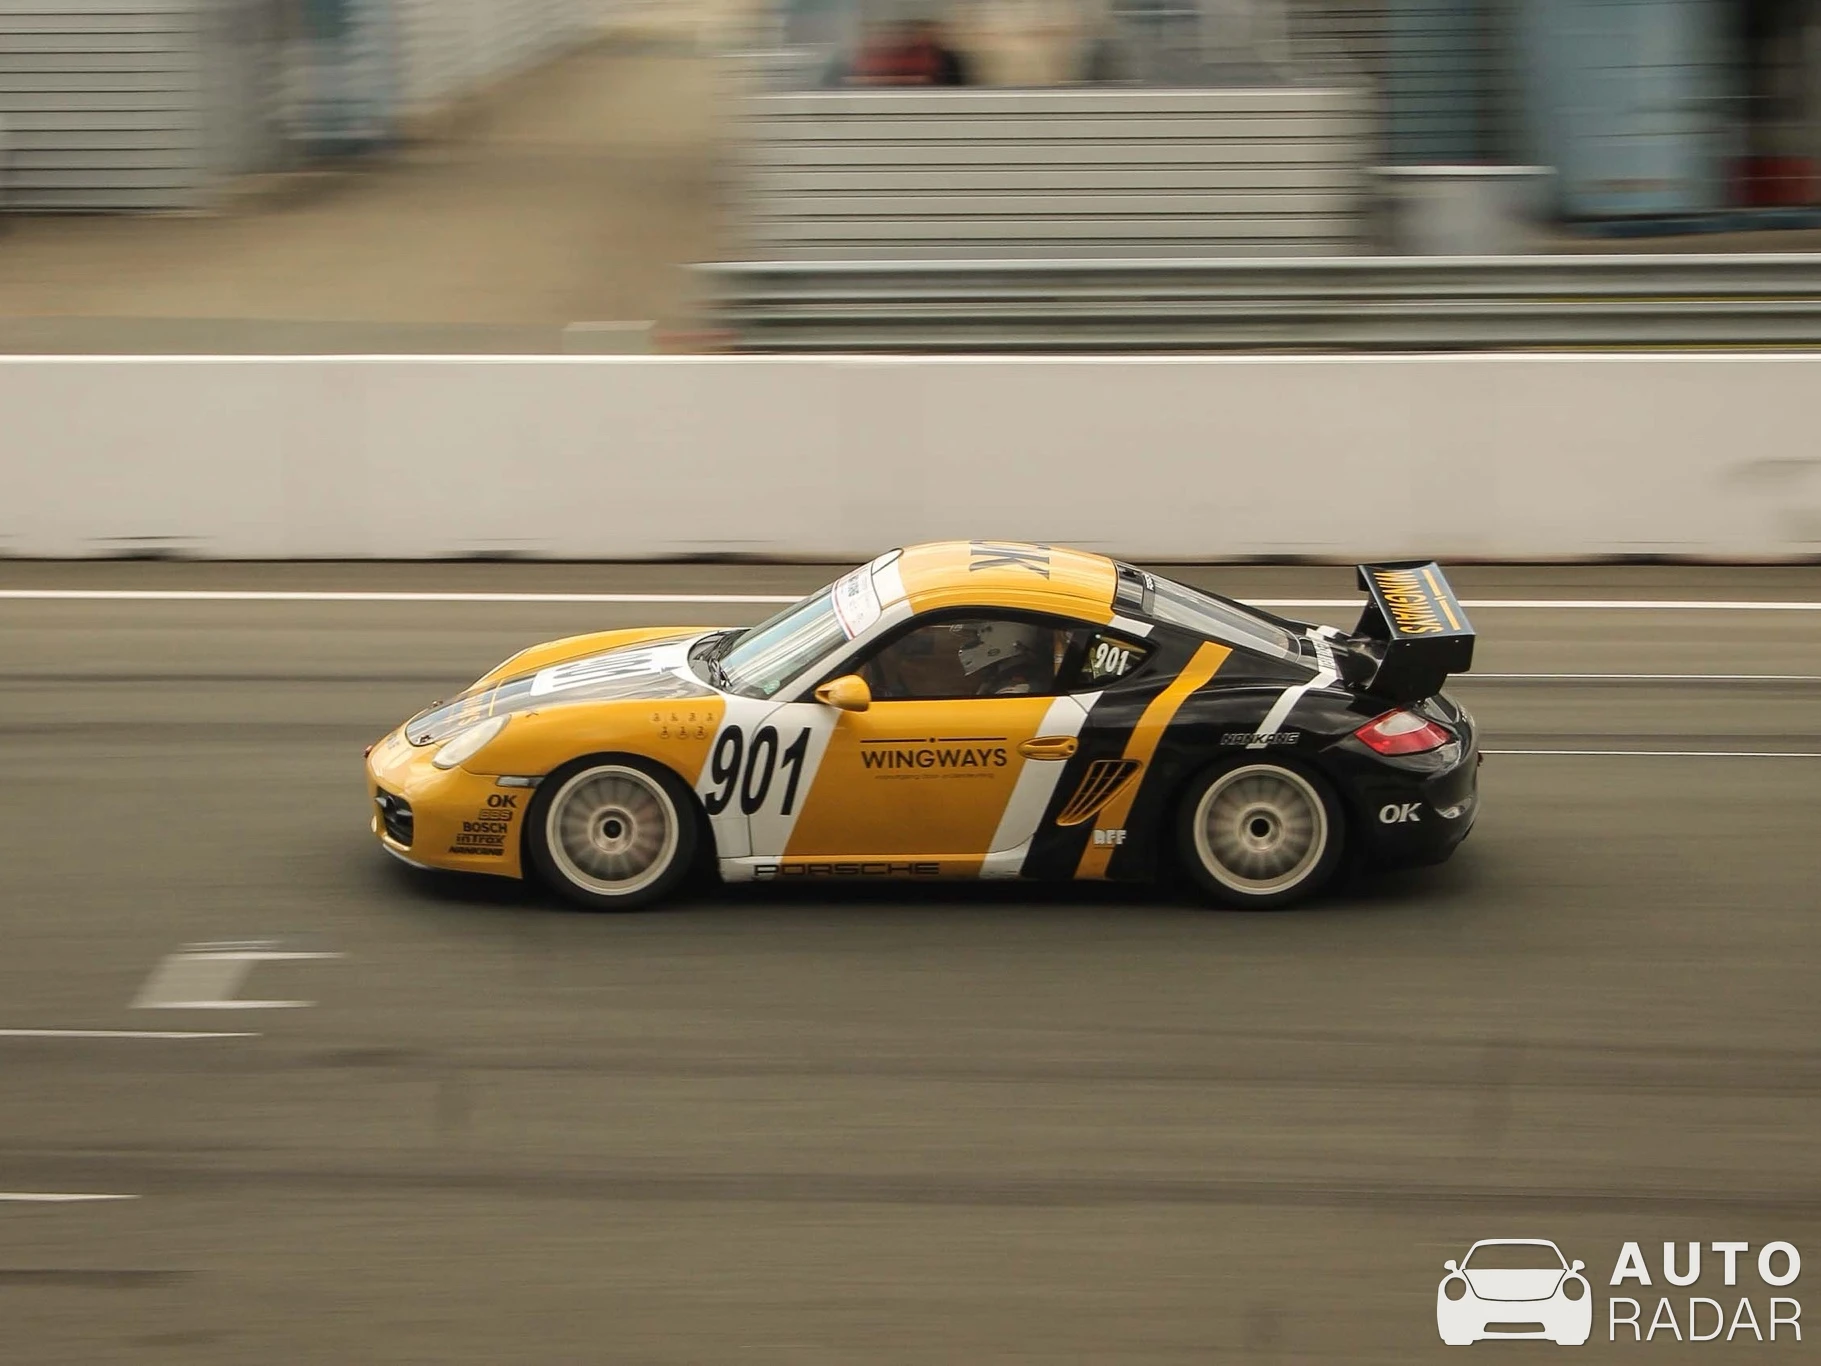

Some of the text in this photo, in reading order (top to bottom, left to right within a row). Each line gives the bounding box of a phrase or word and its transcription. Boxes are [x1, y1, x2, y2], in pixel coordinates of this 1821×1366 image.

[1373, 569, 1444, 635] WINGWAYS
[1094, 643, 1130, 676] 901
[860, 748, 1008, 768] WINGWAYS
[704, 724, 812, 817] 901
[487, 794, 518, 808] OK
[1378, 802, 1423, 825] OK
[463, 821, 508, 833] BOSCH
[754, 862, 940, 877] PORSCHE
